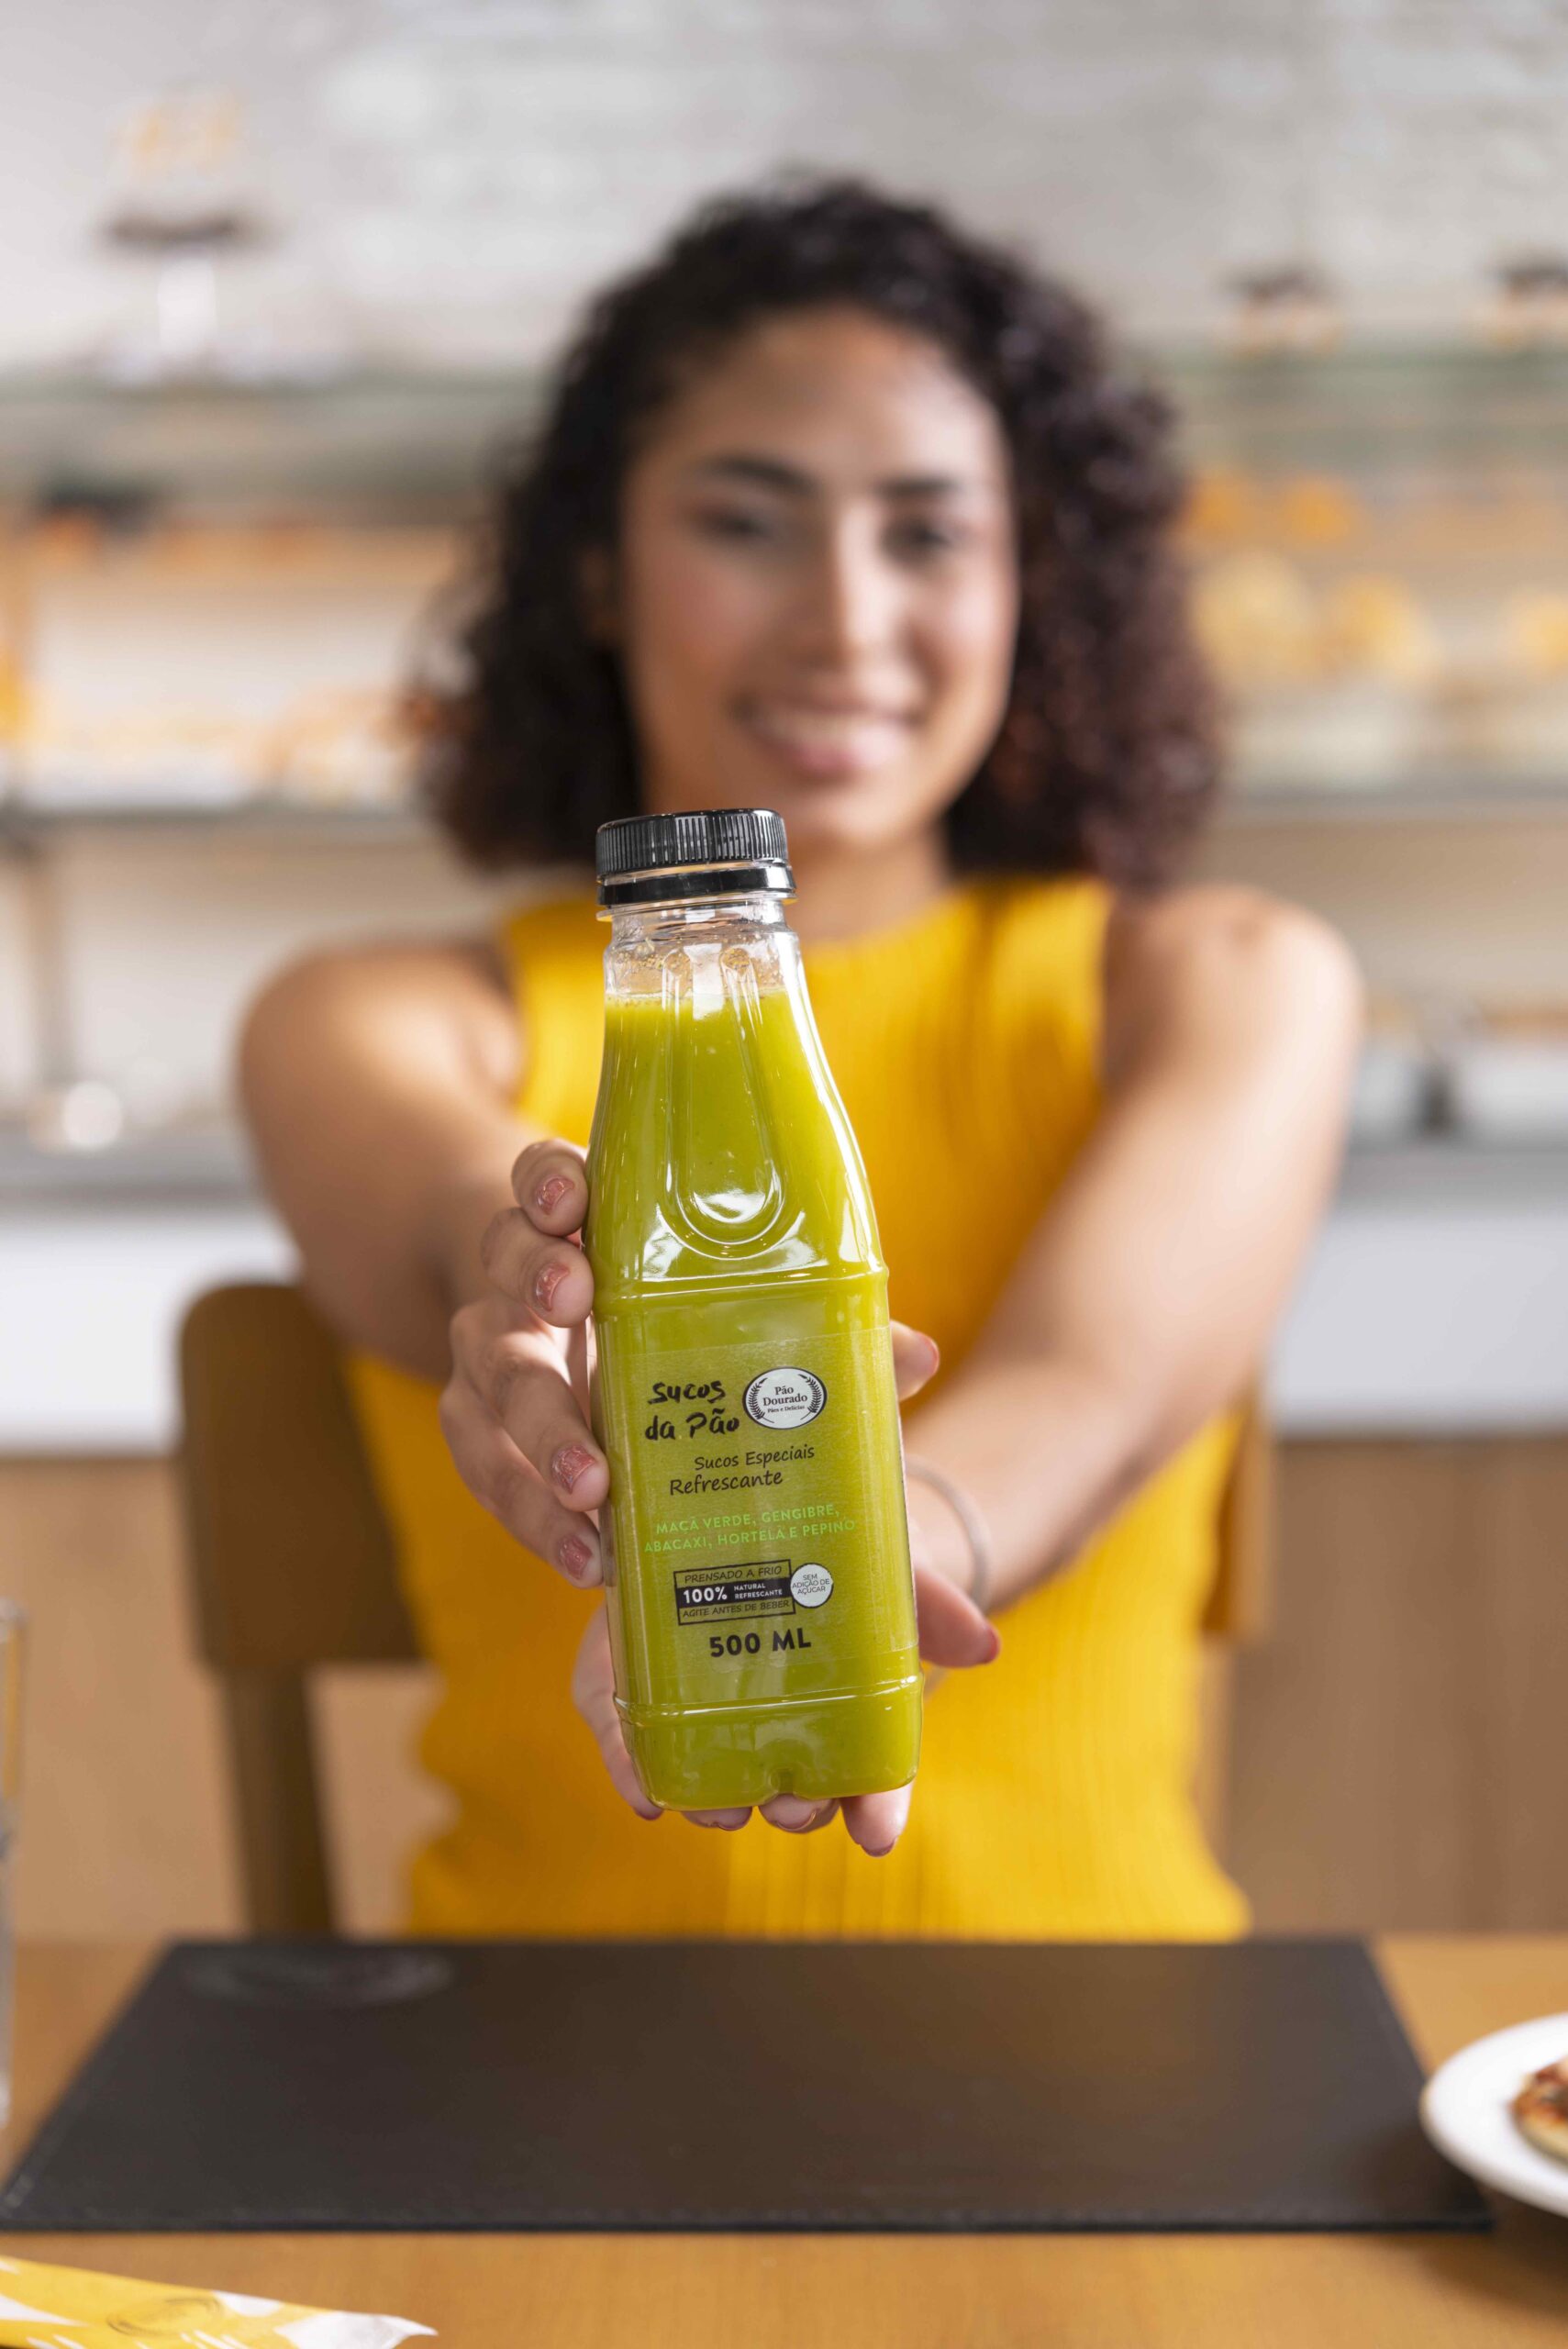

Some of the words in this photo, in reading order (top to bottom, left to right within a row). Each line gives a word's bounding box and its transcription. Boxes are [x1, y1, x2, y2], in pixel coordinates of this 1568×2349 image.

[648, 1379, 726, 1405] Sucos
[762, 1394, 808, 1406] Dourado
[774, 1386, 795, 1396] Pão
[645, 1415, 675, 1441] da
[686, 1409, 740, 1439] Pão
[695, 1456, 739, 1470] Sucos
[746, 1443, 815, 1468] Especiais
[670, 1470, 783, 1496] Refrescante
[657, 1516, 698, 1535] MAÇÃ
[703, 1514, 756, 1531] VERDE,
[762, 1504, 840, 1522] GENGIBRE,
[644, 1537, 713, 1553] ABACAXI,
[789, 1526, 798, 1538] E
[803, 1520, 855, 1536] PEPINO
[685, 1570, 742, 1583] PRENSADO
[746, 1568, 753, 1577] A
[759, 1565, 782, 1576] FRIO
[803, 1573, 817, 1581] SEM
[683, 1586, 728, 1604] 100%
[734, 1583, 765, 1591] NATURAL
[735, 1589, 783, 1598] REFRESCANTE
[683, 1607, 710, 1618] AGITE
[712, 1604, 741, 1615] ANTES
[745, 1603, 757, 1612] DE
[760, 1600, 790, 1611] BEBER
[709, 1633, 761, 1658] 500
[773, 1627, 811, 1650] ML
